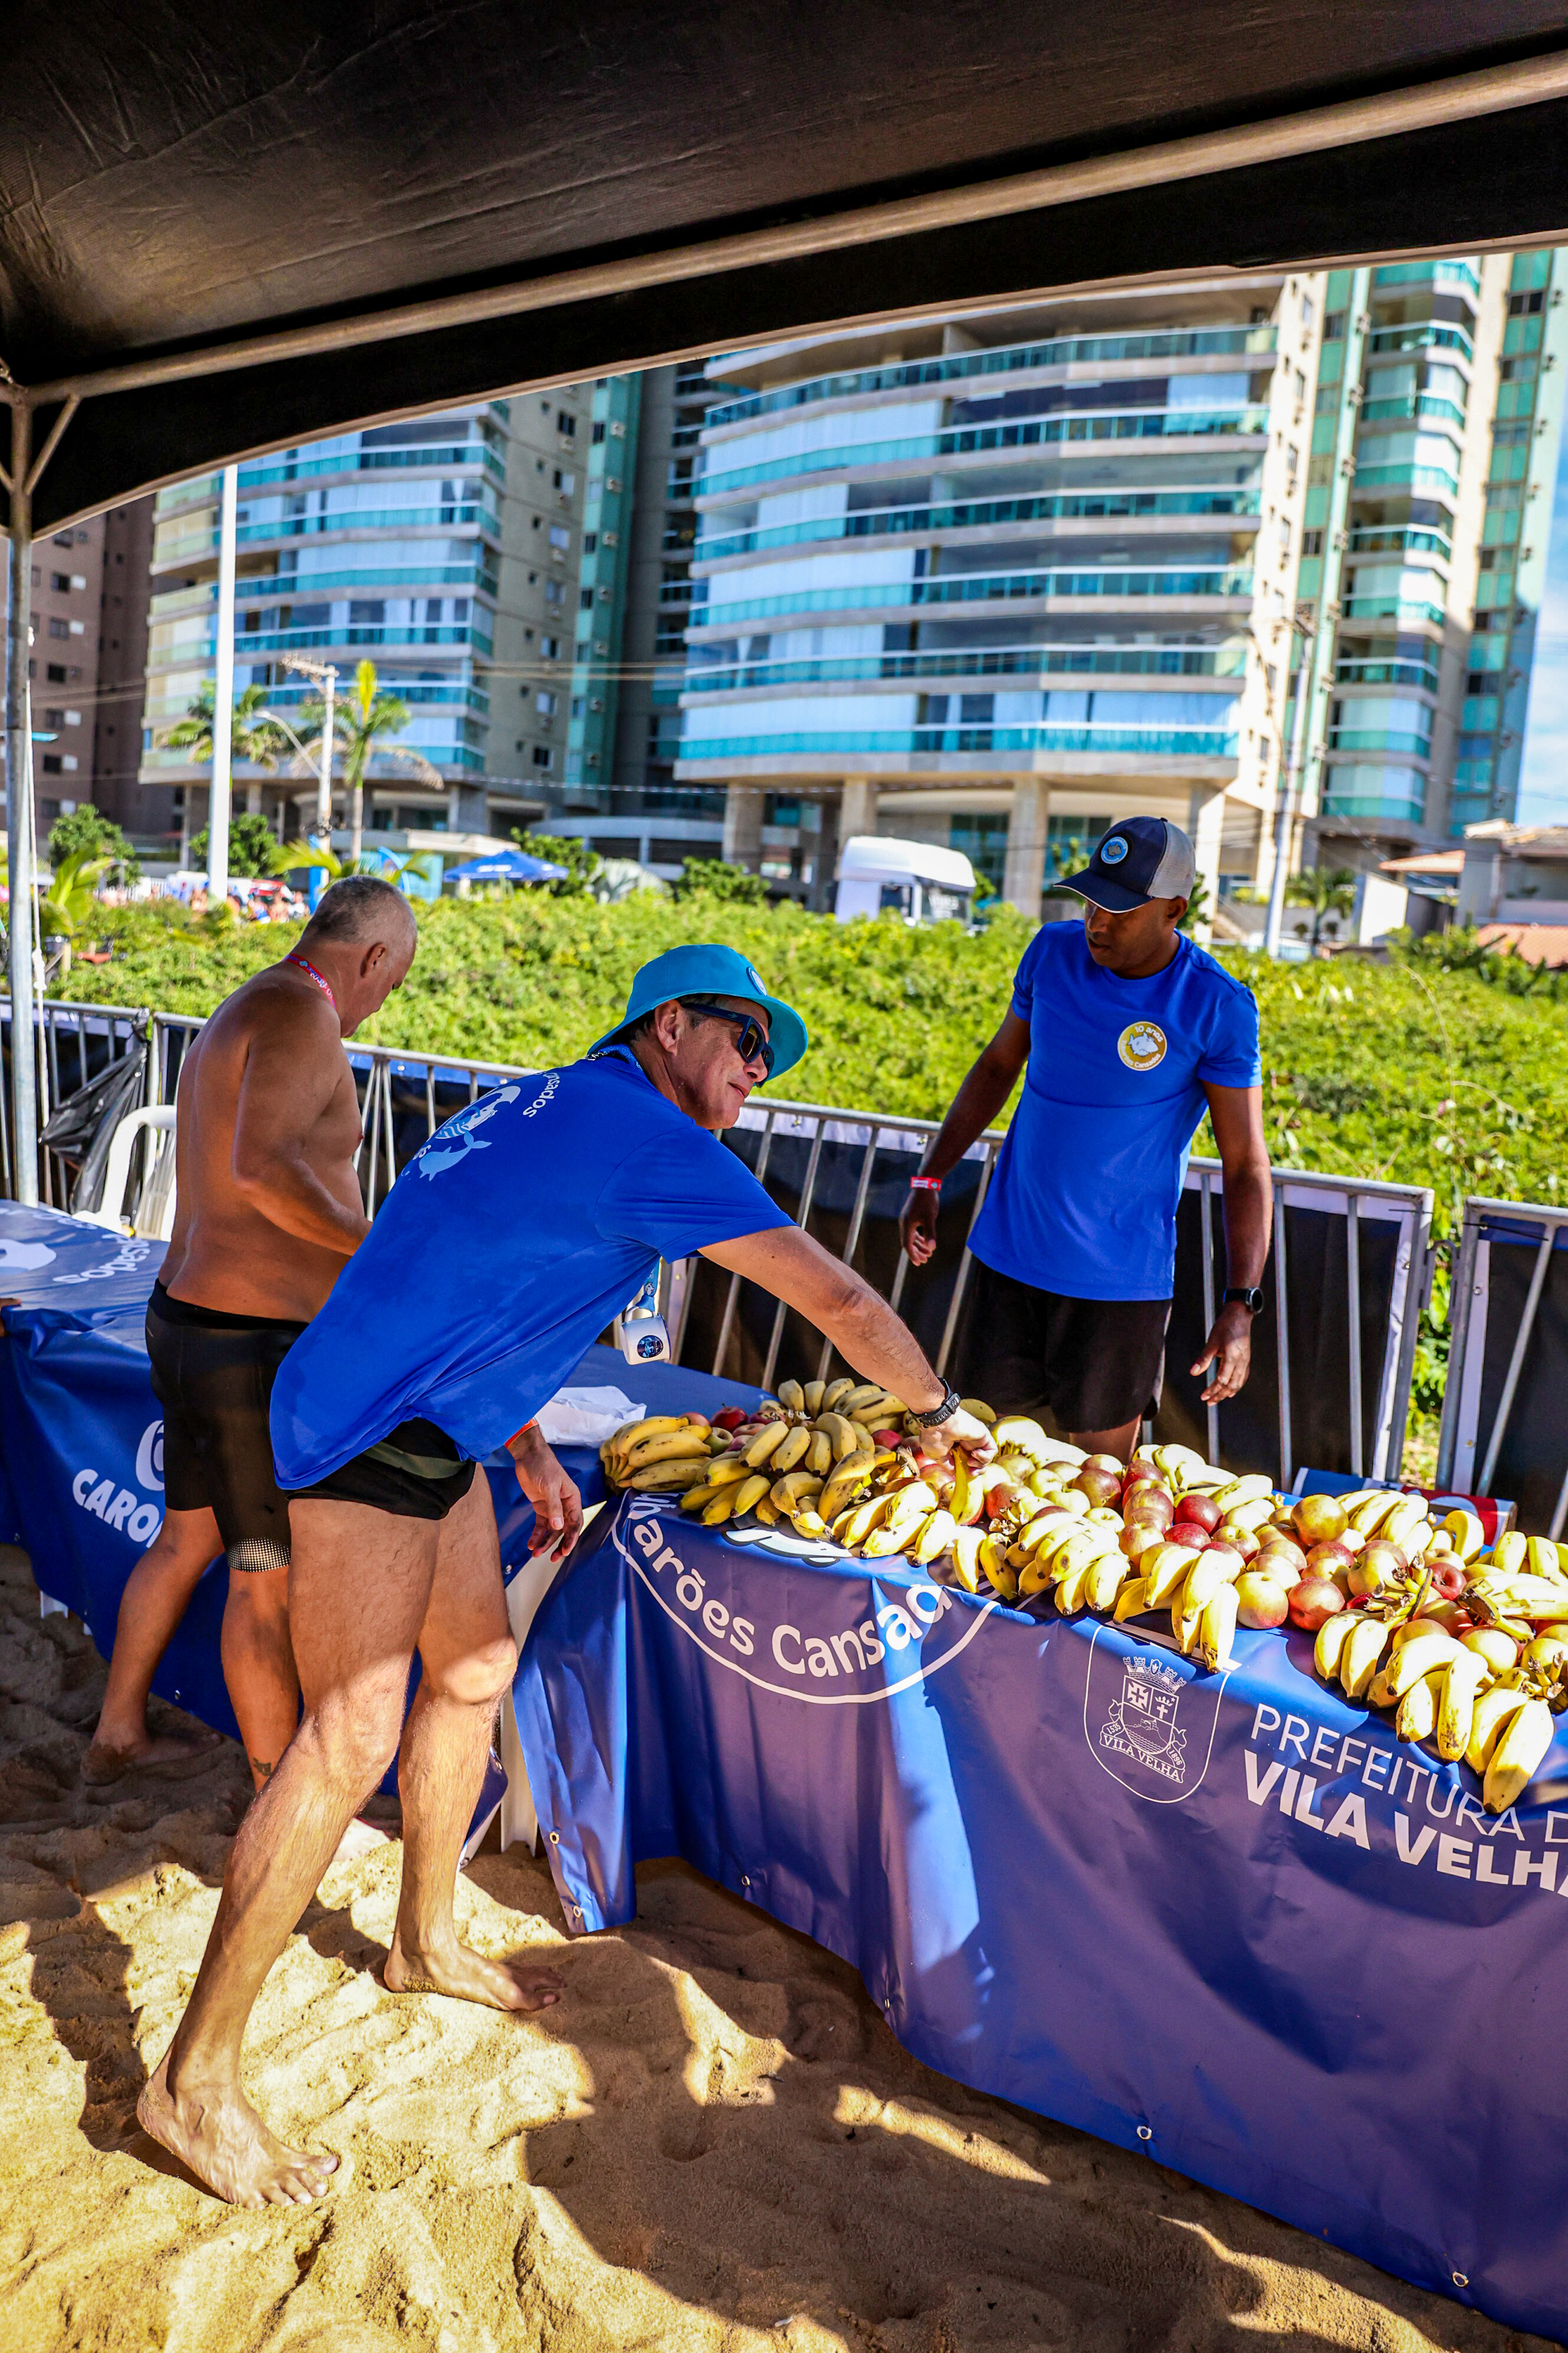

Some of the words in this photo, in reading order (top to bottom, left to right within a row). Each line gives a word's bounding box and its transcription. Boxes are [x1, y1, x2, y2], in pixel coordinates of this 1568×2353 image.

[1146, 1027, 1163, 1042] anos
[628, 1492, 754, 1656] ubarões
[772, 1584, 953, 1677] Cansad
[1106, 1722, 1121, 1735] 1535
[1104, 1734, 1135, 1757] VILA
[1137, 1749, 1181, 1782] VELHA
[1168, 1749, 1183, 1766] 1896
[1250, 1704, 1526, 1841] PREFEITURA
[1243, 1749, 1371, 1850] VILA
[1394, 1810, 1568, 1899] VELH
